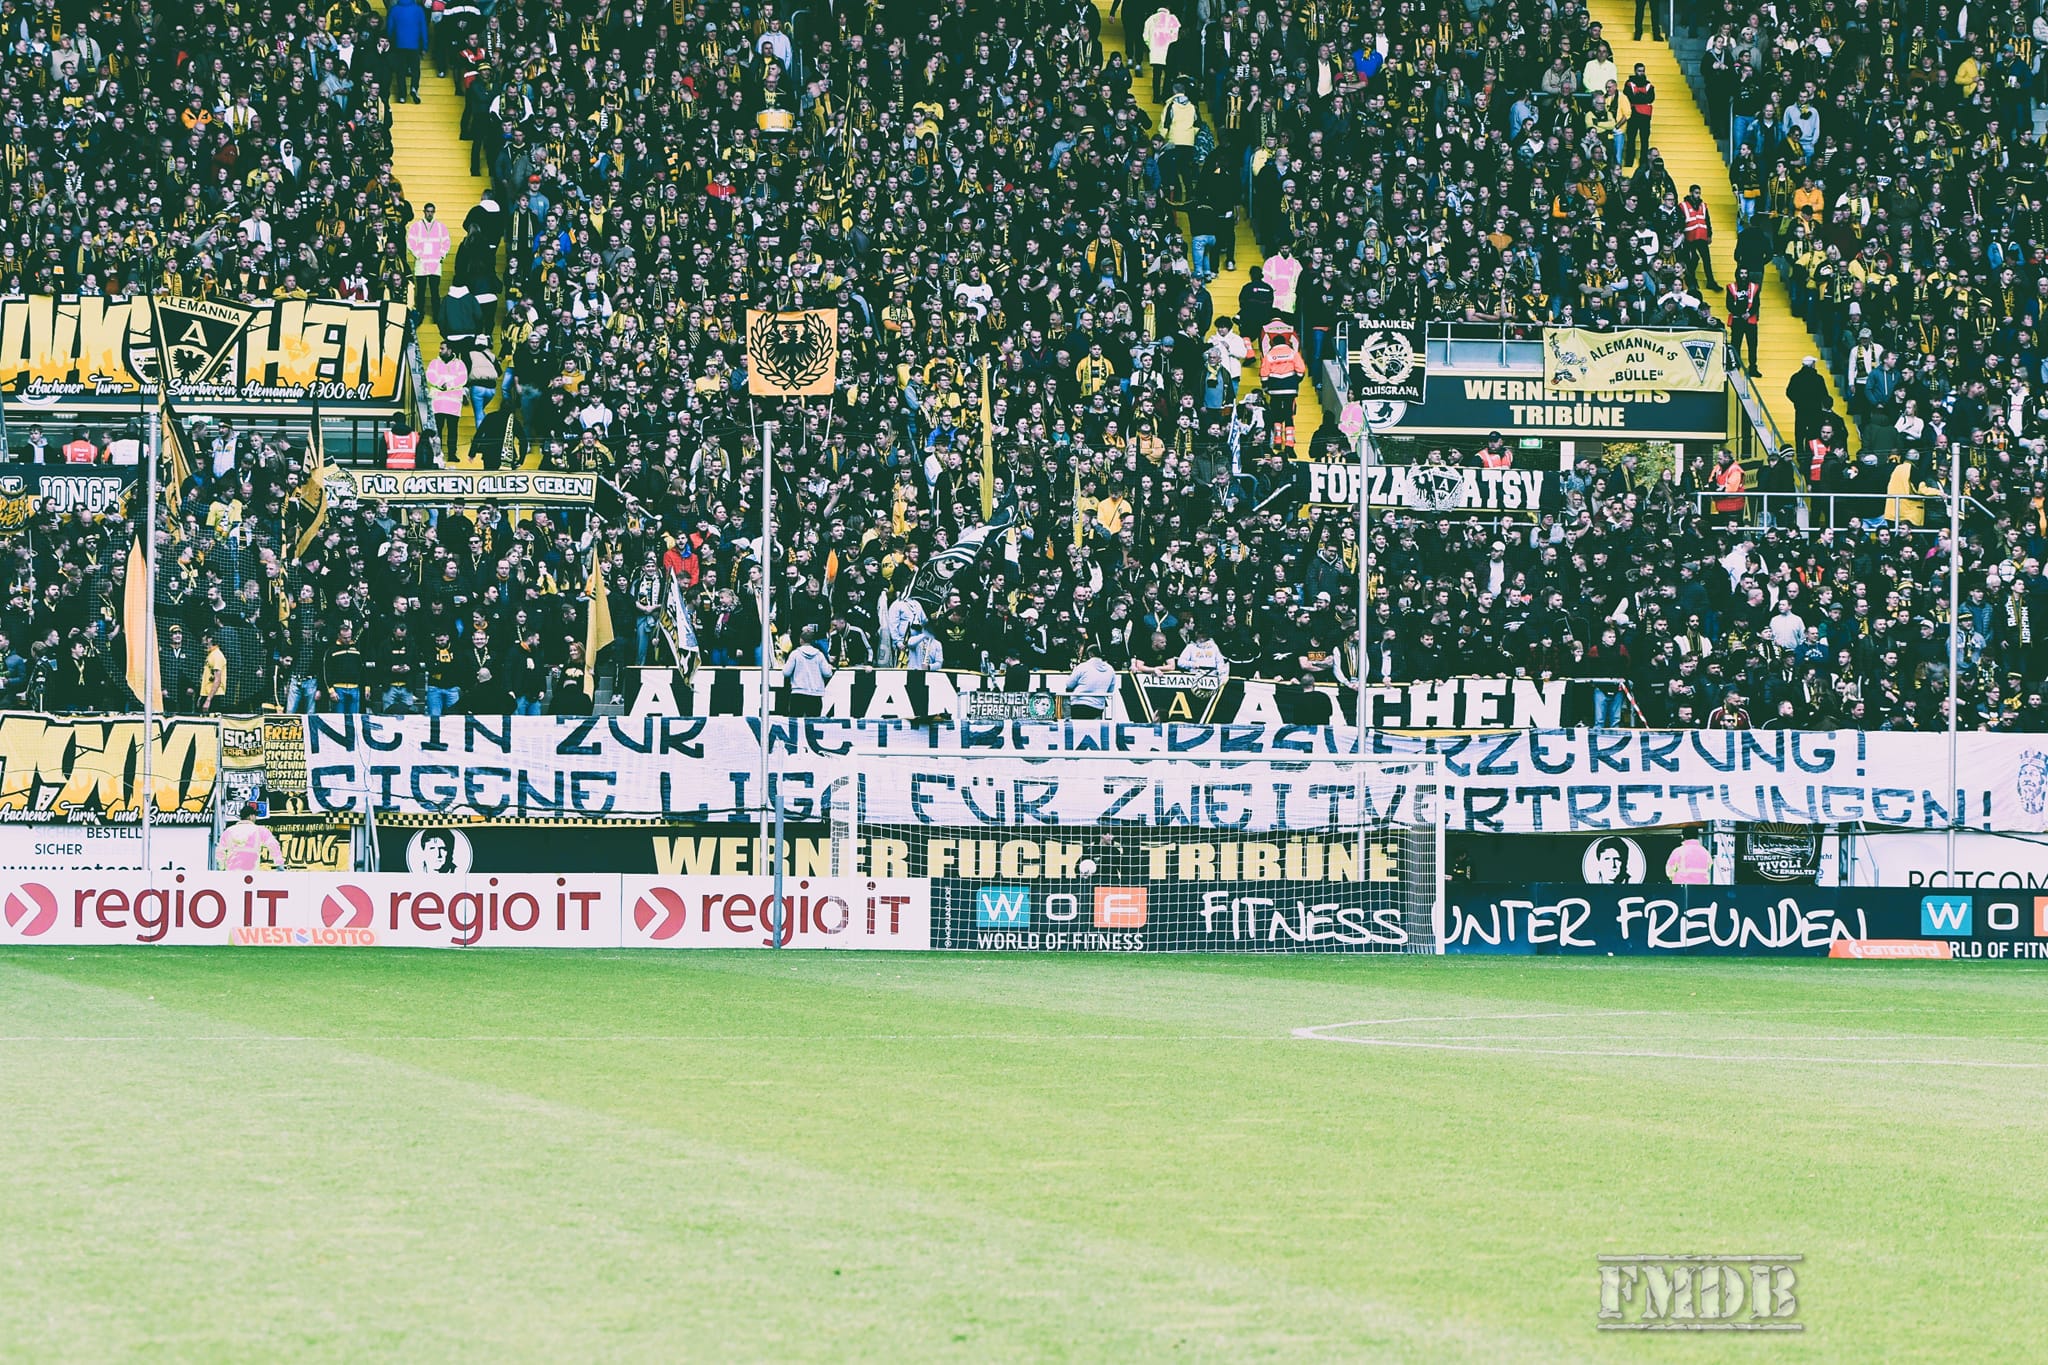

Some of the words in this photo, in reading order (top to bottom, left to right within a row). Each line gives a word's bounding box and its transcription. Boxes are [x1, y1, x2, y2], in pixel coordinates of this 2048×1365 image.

[160, 296, 242, 323] ALEMANNIA
[180, 320, 208, 347] A
[1359, 320, 1415, 330] RABAUKEN
[1626, 353, 1645, 363] AU
[27, 377, 84, 395] Aachener
[88, 374, 133, 396] Turn-
[167, 379, 236, 399] Sportverein
[241, 379, 304, 400] Alemannia
[1362, 386, 1419, 396] QUISGRANA
[1510, 402, 1625, 427] TRIBÜNE
[363, 474, 398, 494] FÜR
[404, 475, 472, 494] AACHEN
[477, 475, 528, 494] ALLES
[534, 477, 593, 496] GEBEN!
[1461, 469, 1544, 509] ATSV
[970, 692, 1029, 705] LEGENDEN
[1168, 692, 1193, 719] A
[307, 714, 511, 754] NEIN
[556, 715, 707, 758] ZUR
[311, 765, 617, 820] EIGENE
[911, 772, 1060, 825] FÜR
[0, 803, 55, 822] Aachener
[114, 806, 139, 822] und
[87, 827, 144, 839] BESTELL
[34, 843, 83, 855] SICHER
[1140, 836, 1400, 881] TRIBÜNE
[1757, 859, 1802, 871] TIVOLI
[74, 874, 227, 942] regio
[243, 875, 289, 928] iT
[389, 877, 539, 946] regio
[556, 877, 602, 931] iT
[701, 880, 848, 946] regio
[1201, 891, 1408, 945] FITNESS
[1616, 897, 1868, 949] FREUNDEN
[977, 933, 1041, 950] WORLD
[1046, 933, 1066, 950] OF
[1073, 933, 1144, 951] FITNESS
[1988, 941, 2009, 959] OF
